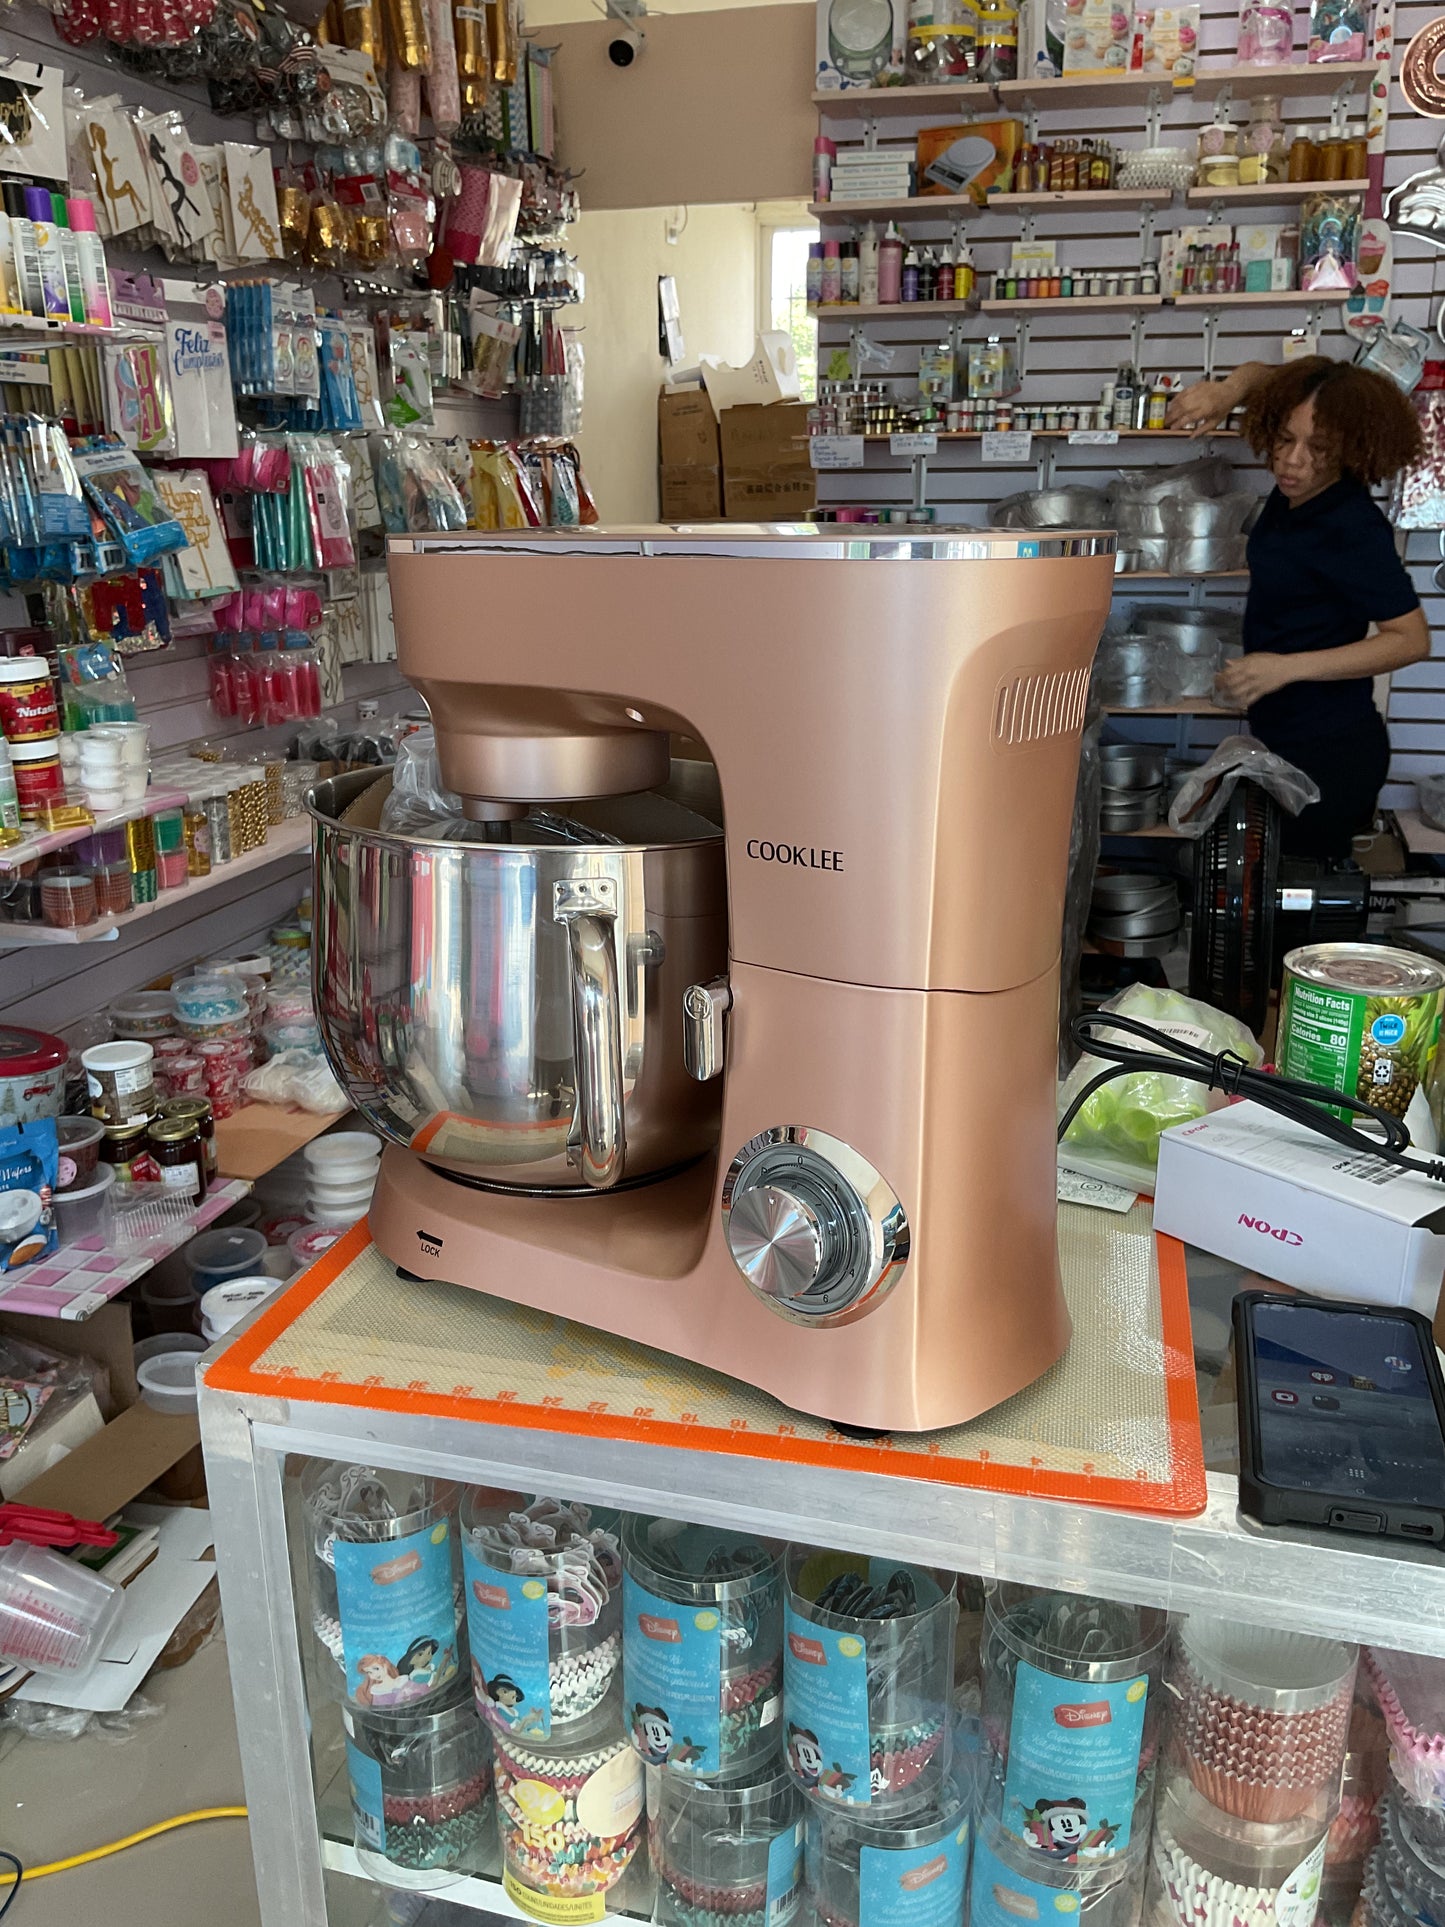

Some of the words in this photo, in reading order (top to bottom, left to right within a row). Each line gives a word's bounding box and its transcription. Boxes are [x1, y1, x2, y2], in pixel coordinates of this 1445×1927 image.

[175, 328, 209, 356] Feliz
[746, 839, 844, 872] COOKLEE
[1369, 895, 1396, 910] INJA
[1295, 986, 1324, 1006] Nutrition
[1325, 996, 1350, 1011] Facts
[1291, 1023, 1321, 1041] Calories
[1330, 1034, 1346, 1047] 80
[797, 1156, 803, 1165] 0
[853, 1227, 859, 1238] 2
[1238, 1213, 1304, 1246] CPON
[421, 1242, 440, 1258] LOCK
[849, 1268, 855, 1278] 4
[822, 1294, 829, 1303] 6
[320, 1371, 342, 1382] 34
[363, 1375, 385, 1387] 32
[408, 1380, 429, 1391] 30
[452, 1385, 474, 1397] 28
[497, 1391, 518, 1401] 26
[542, 1396, 564, 1406] 24
[587, 1401, 608, 1412] 22
[633, 1407, 654, 1417] 20
[681, 1413, 699, 1423] 18
[730, 1418, 748, 1430] 16
[778, 1424, 796, 1435] 14
[825, 1430, 844, 1442] 12
[1030, 1456, 1042, 1465] 4
[1083, 1462, 1095, 1474] 2
[381, 1559, 420, 1579] Disney
[643, 1617, 679, 1640] Disney
[1060, 1706, 1109, 1722] Disney
[521, 1822, 566, 1851] 150
[908, 1861, 946, 1884] Disney
[510, 1881, 522, 1896] 150
